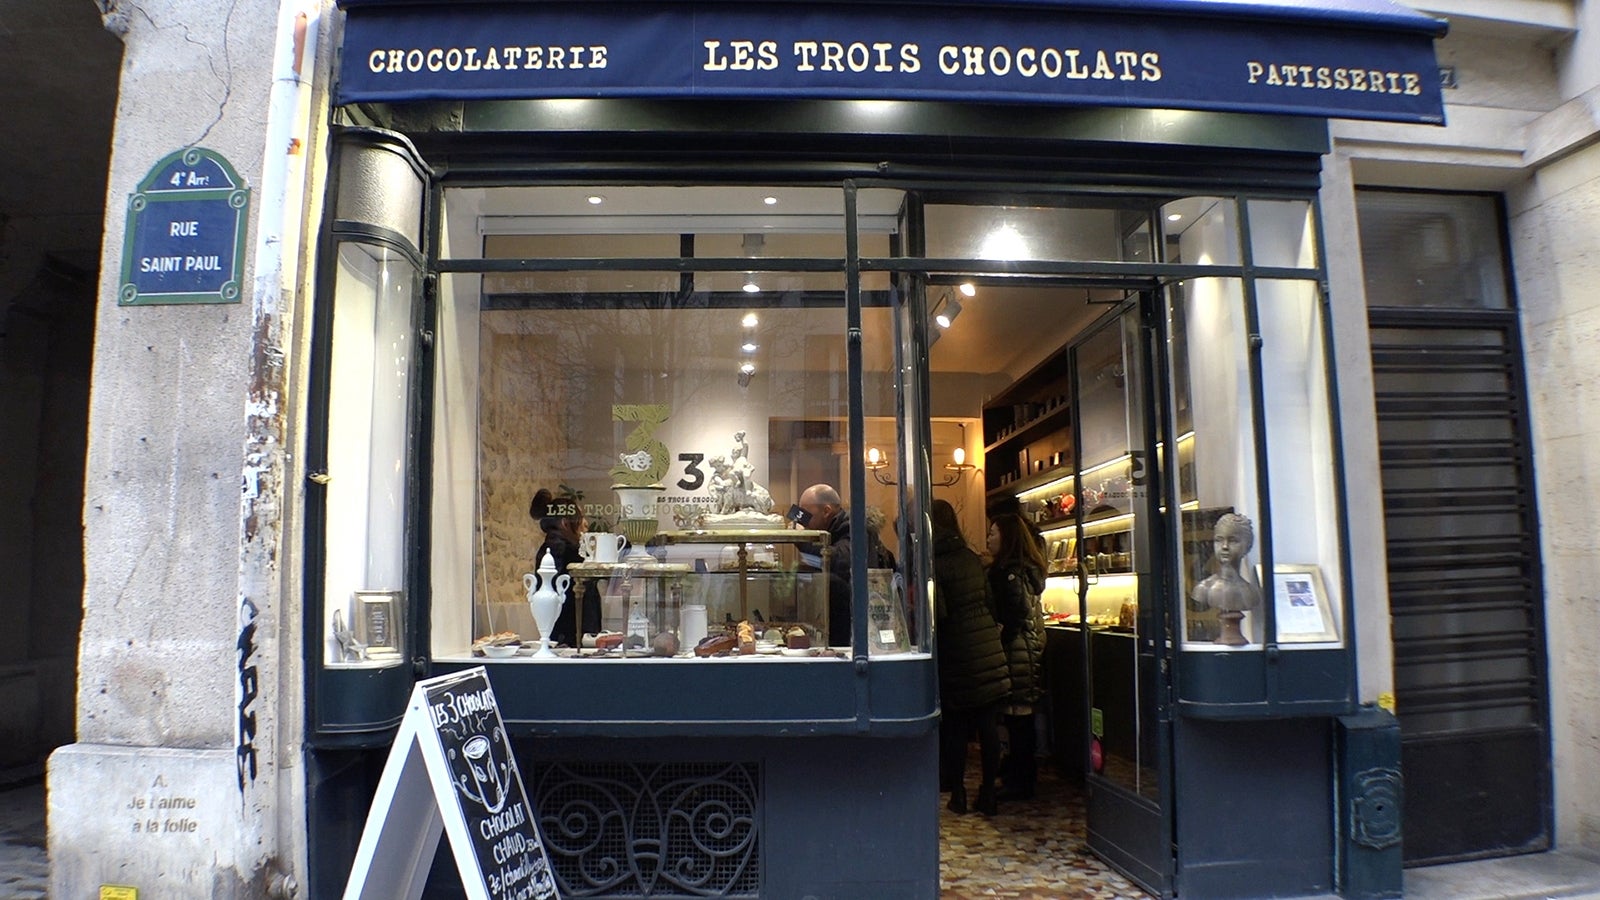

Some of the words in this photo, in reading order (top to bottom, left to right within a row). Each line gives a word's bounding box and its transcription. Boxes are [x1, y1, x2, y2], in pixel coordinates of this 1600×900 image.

[368, 46, 609, 75] CHOCOLATERIE
[703, 41, 779, 72] LES
[794, 42, 921, 74] TROIS
[938, 45, 1163, 83] CHOCOLATS
[1246, 61, 1422, 97] PATISSERIE
[170, 221, 199, 237] RUE
[140, 257, 183, 273] SAINT
[185, 256, 222, 271] PAUL
[676, 453, 705, 491] 3
[546, 504, 577, 516] LES
[584, 504, 634, 516] TROIS
[430, 703, 449, 728] LES
[443, 692, 460, 723] 3
[127, 797, 145, 809] Je
[150, 796, 196, 809] taime
[146, 819, 159, 833] la
[163, 817, 198, 833] folie
[480, 803, 525, 840] CHOCOLAT
[493, 832, 526, 864] CHAUD
